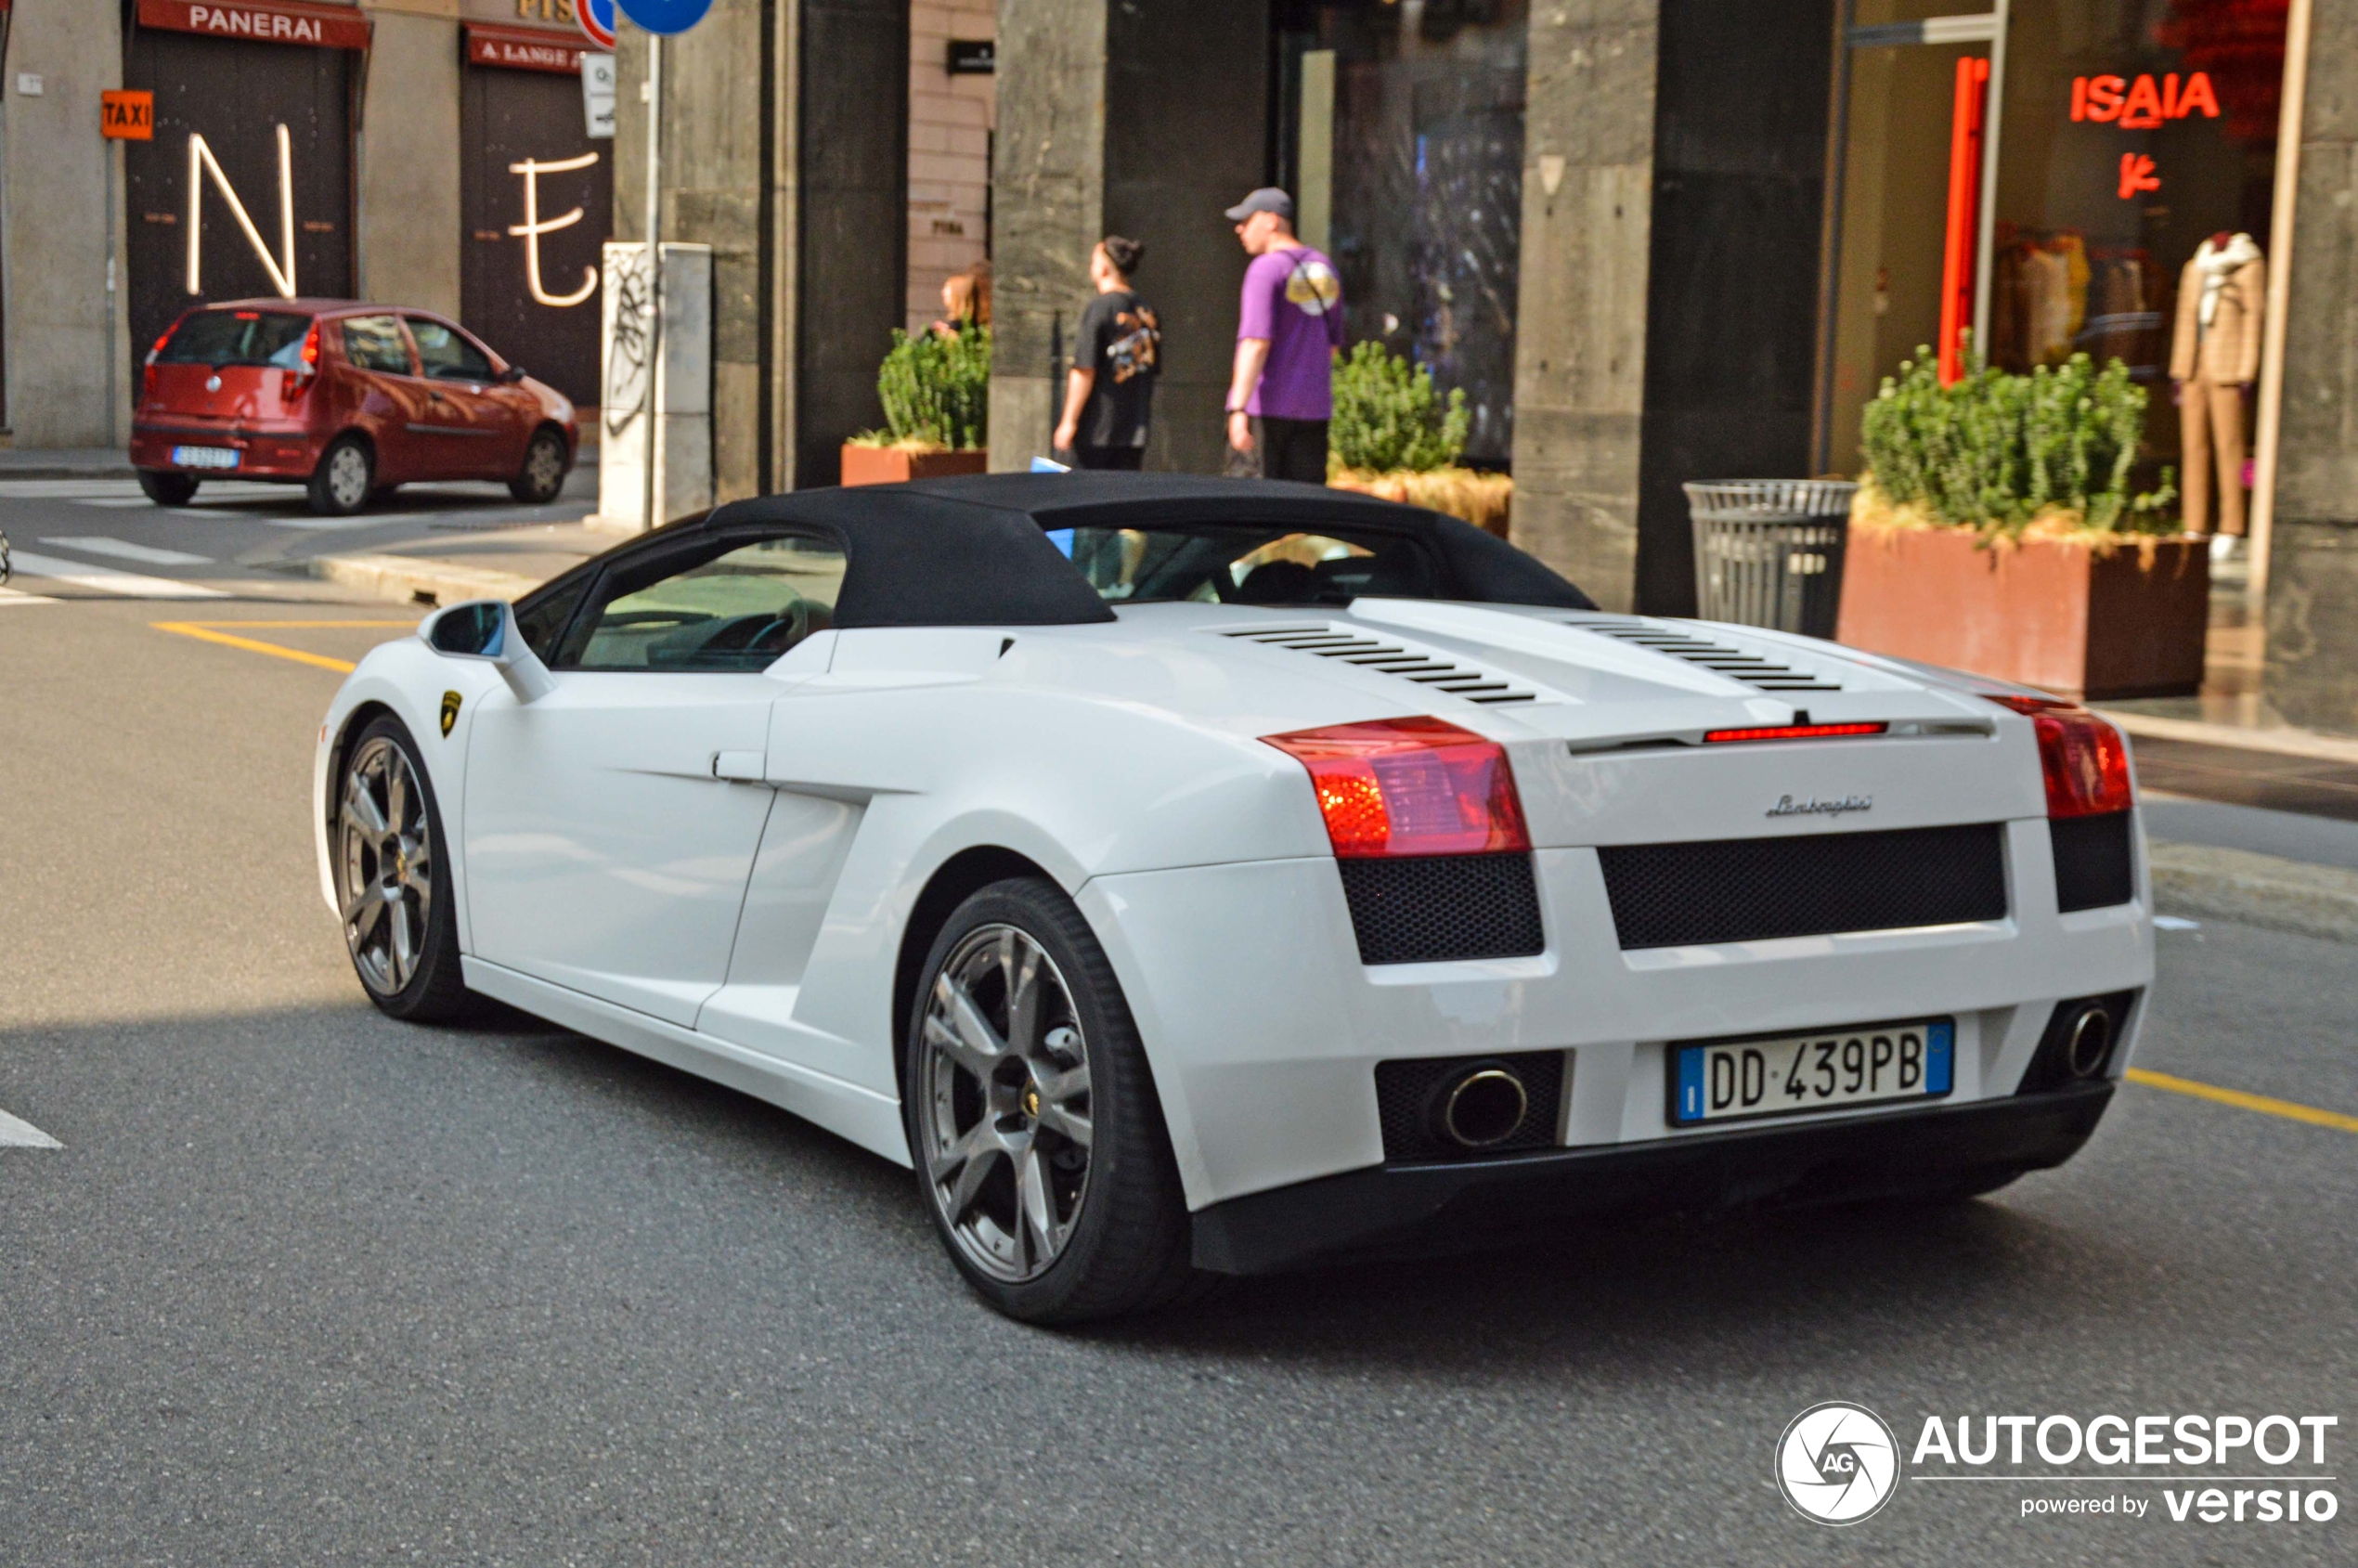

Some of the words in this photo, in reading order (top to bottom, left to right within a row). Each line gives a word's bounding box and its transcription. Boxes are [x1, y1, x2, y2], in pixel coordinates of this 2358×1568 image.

[189, 6, 321, 42] PANERAI
[504, 44, 568, 67] LANGE
[104, 102, 150, 126] TAXI
[2070, 71, 2220, 129] ISAIA
[1766, 795, 1872, 818] Lamborghini
[1712, 1049, 1764, 1110] DD
[1785, 1033, 1921, 1100] 439PB
